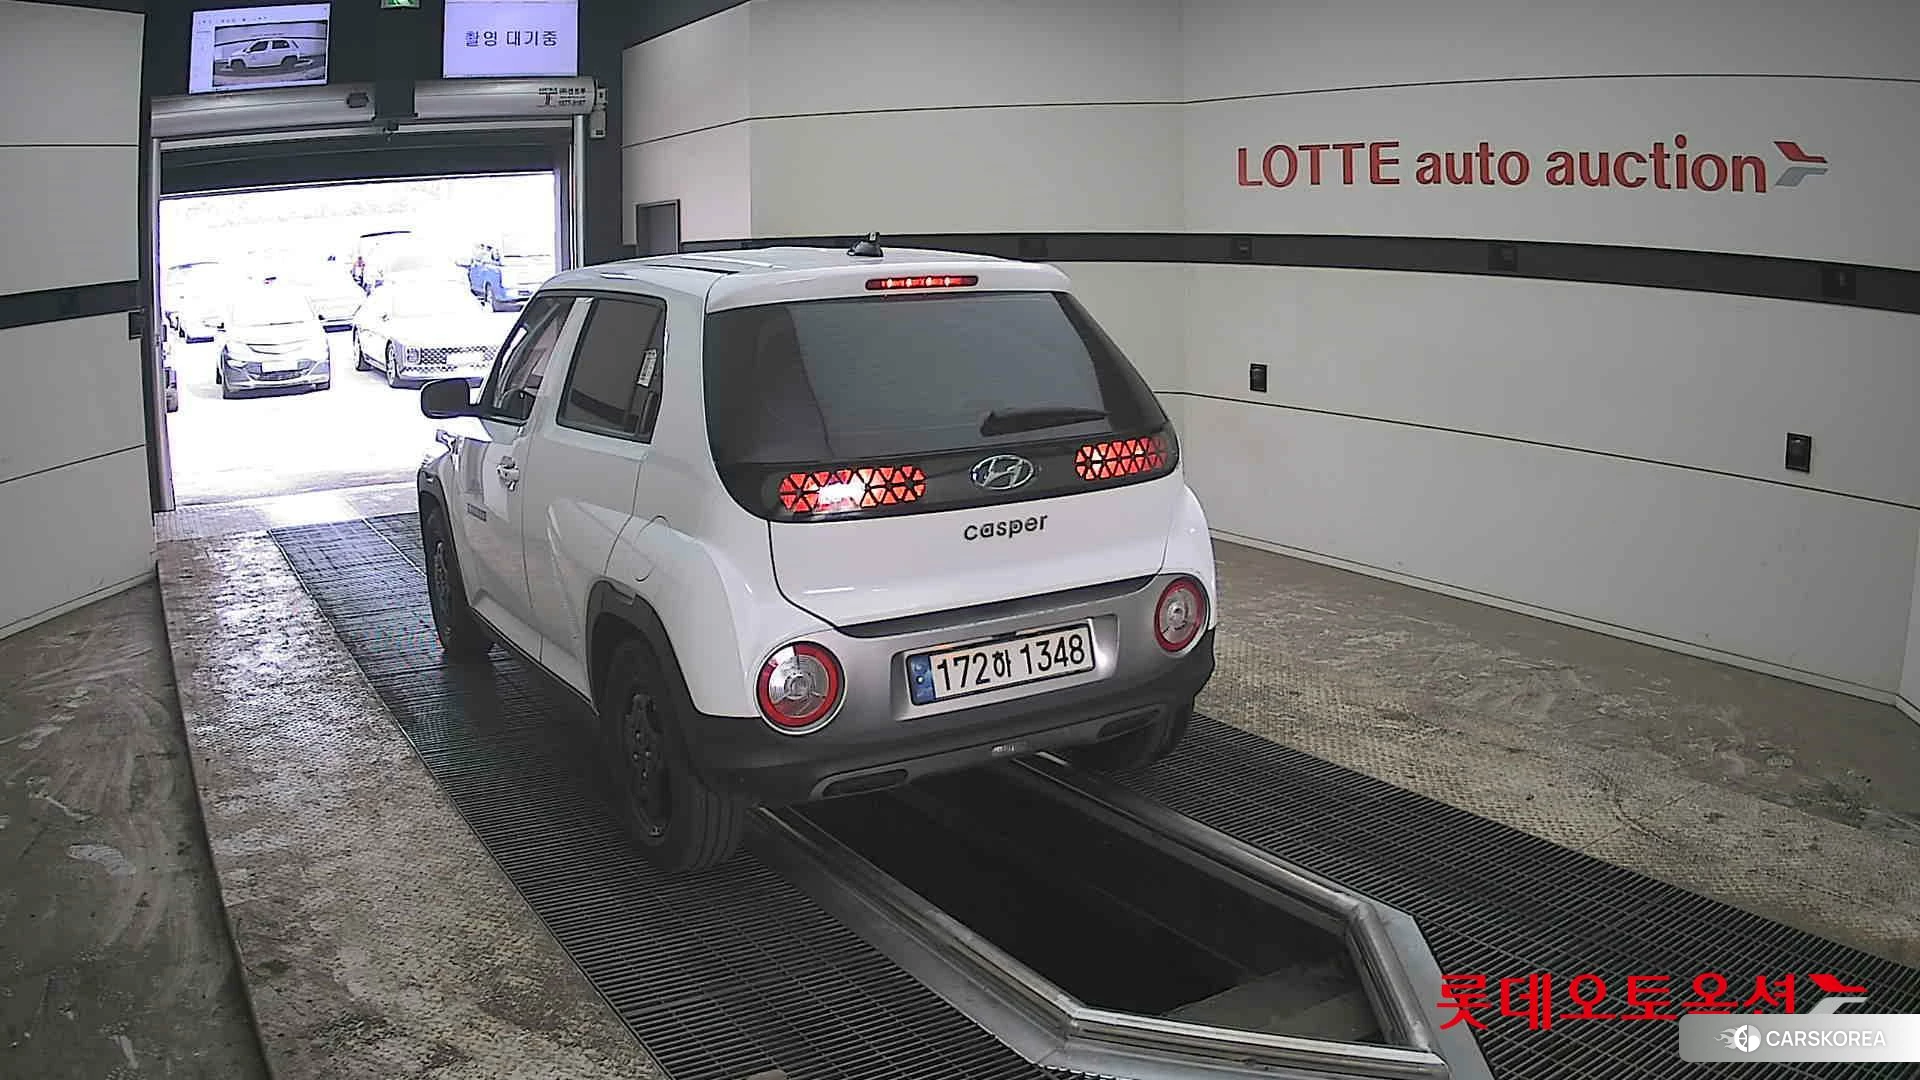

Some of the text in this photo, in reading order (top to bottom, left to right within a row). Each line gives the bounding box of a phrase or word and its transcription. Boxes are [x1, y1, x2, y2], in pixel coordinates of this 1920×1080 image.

[506, 30, 557, 47] 대기중
[1238, 133, 1767, 194] LOTTE auto auction
[963, 514, 1049, 541] casper
[936, 633, 1086, 691] 172하 1348
